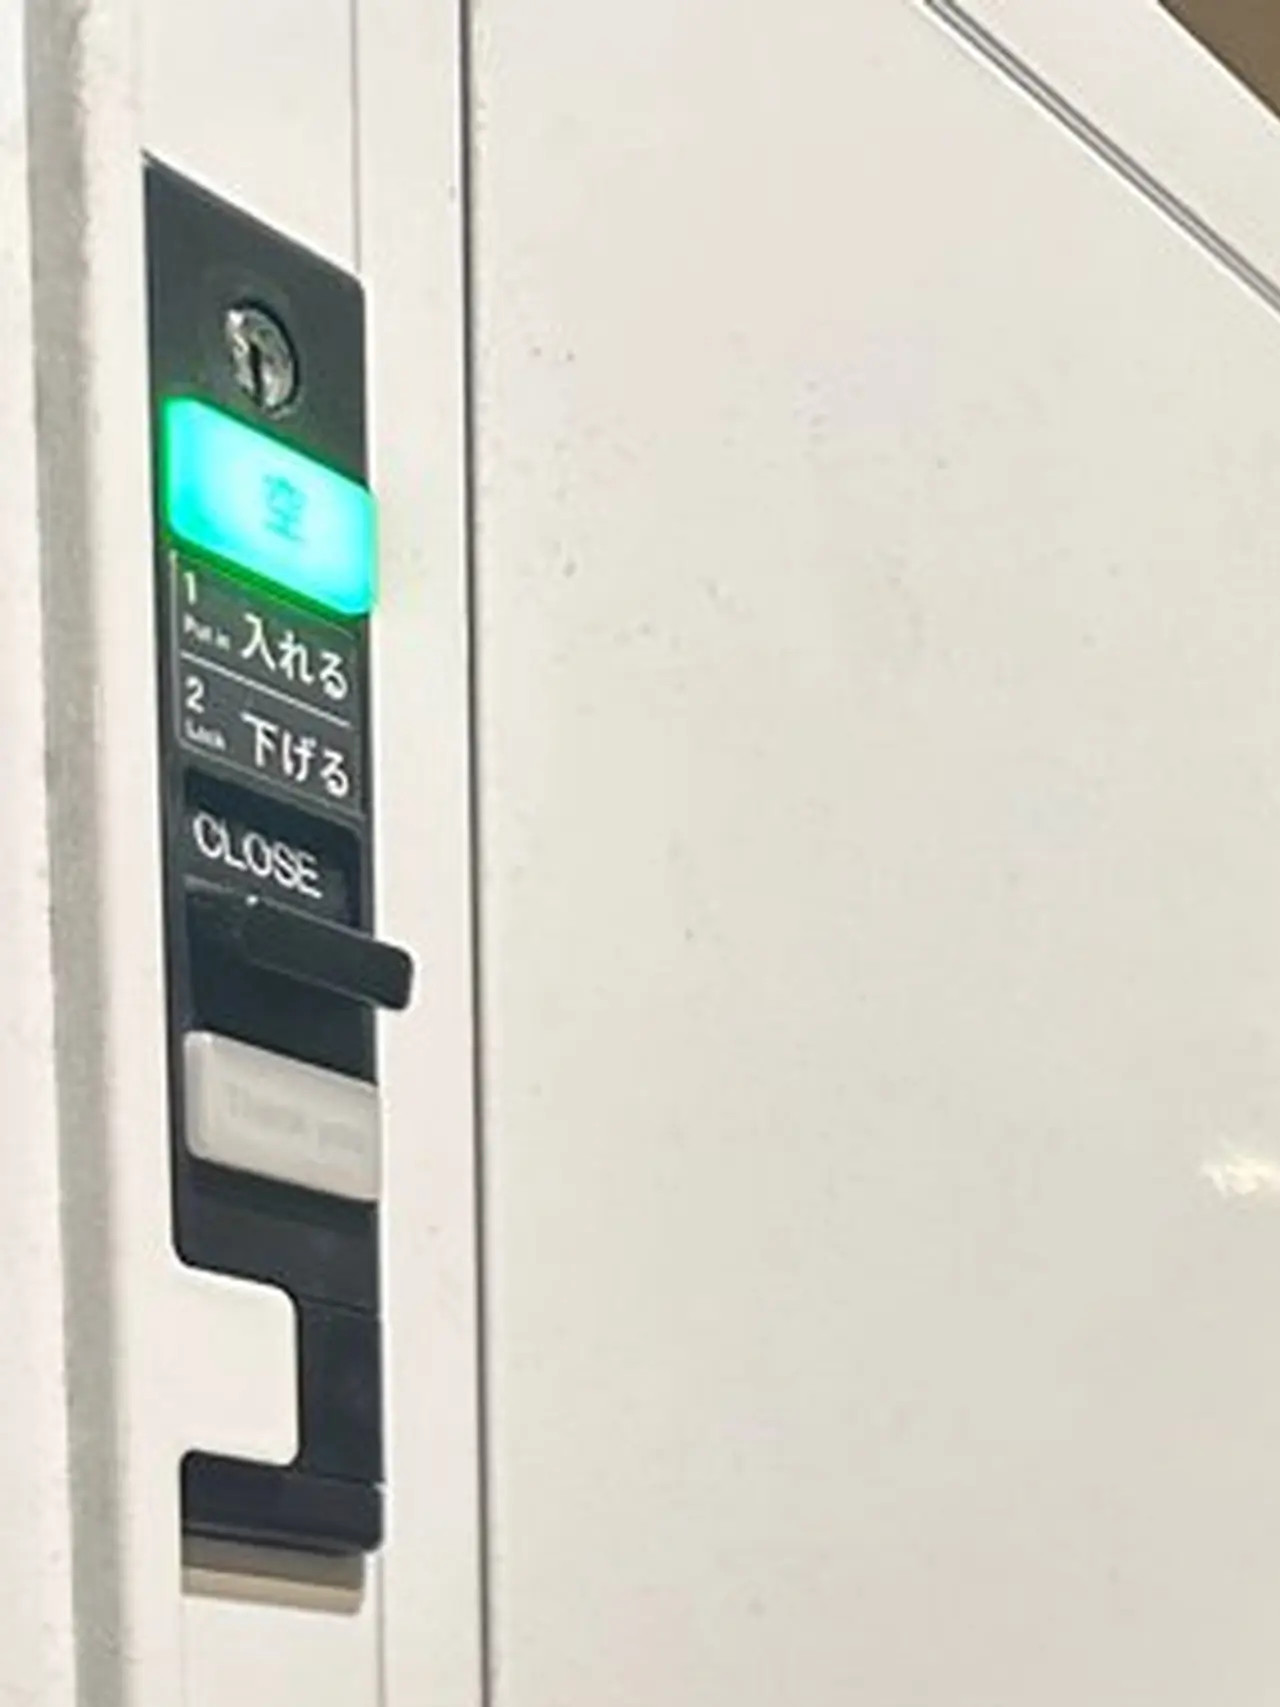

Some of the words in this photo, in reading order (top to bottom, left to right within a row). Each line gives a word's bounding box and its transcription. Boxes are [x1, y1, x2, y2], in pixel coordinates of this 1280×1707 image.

[184, 571, 197, 605] 1
[185, 676, 206, 714] 2
[241, 612, 349, 699] 入れる
[240, 711, 349, 797] 下げる
[193, 812, 323, 899] CLOSE
